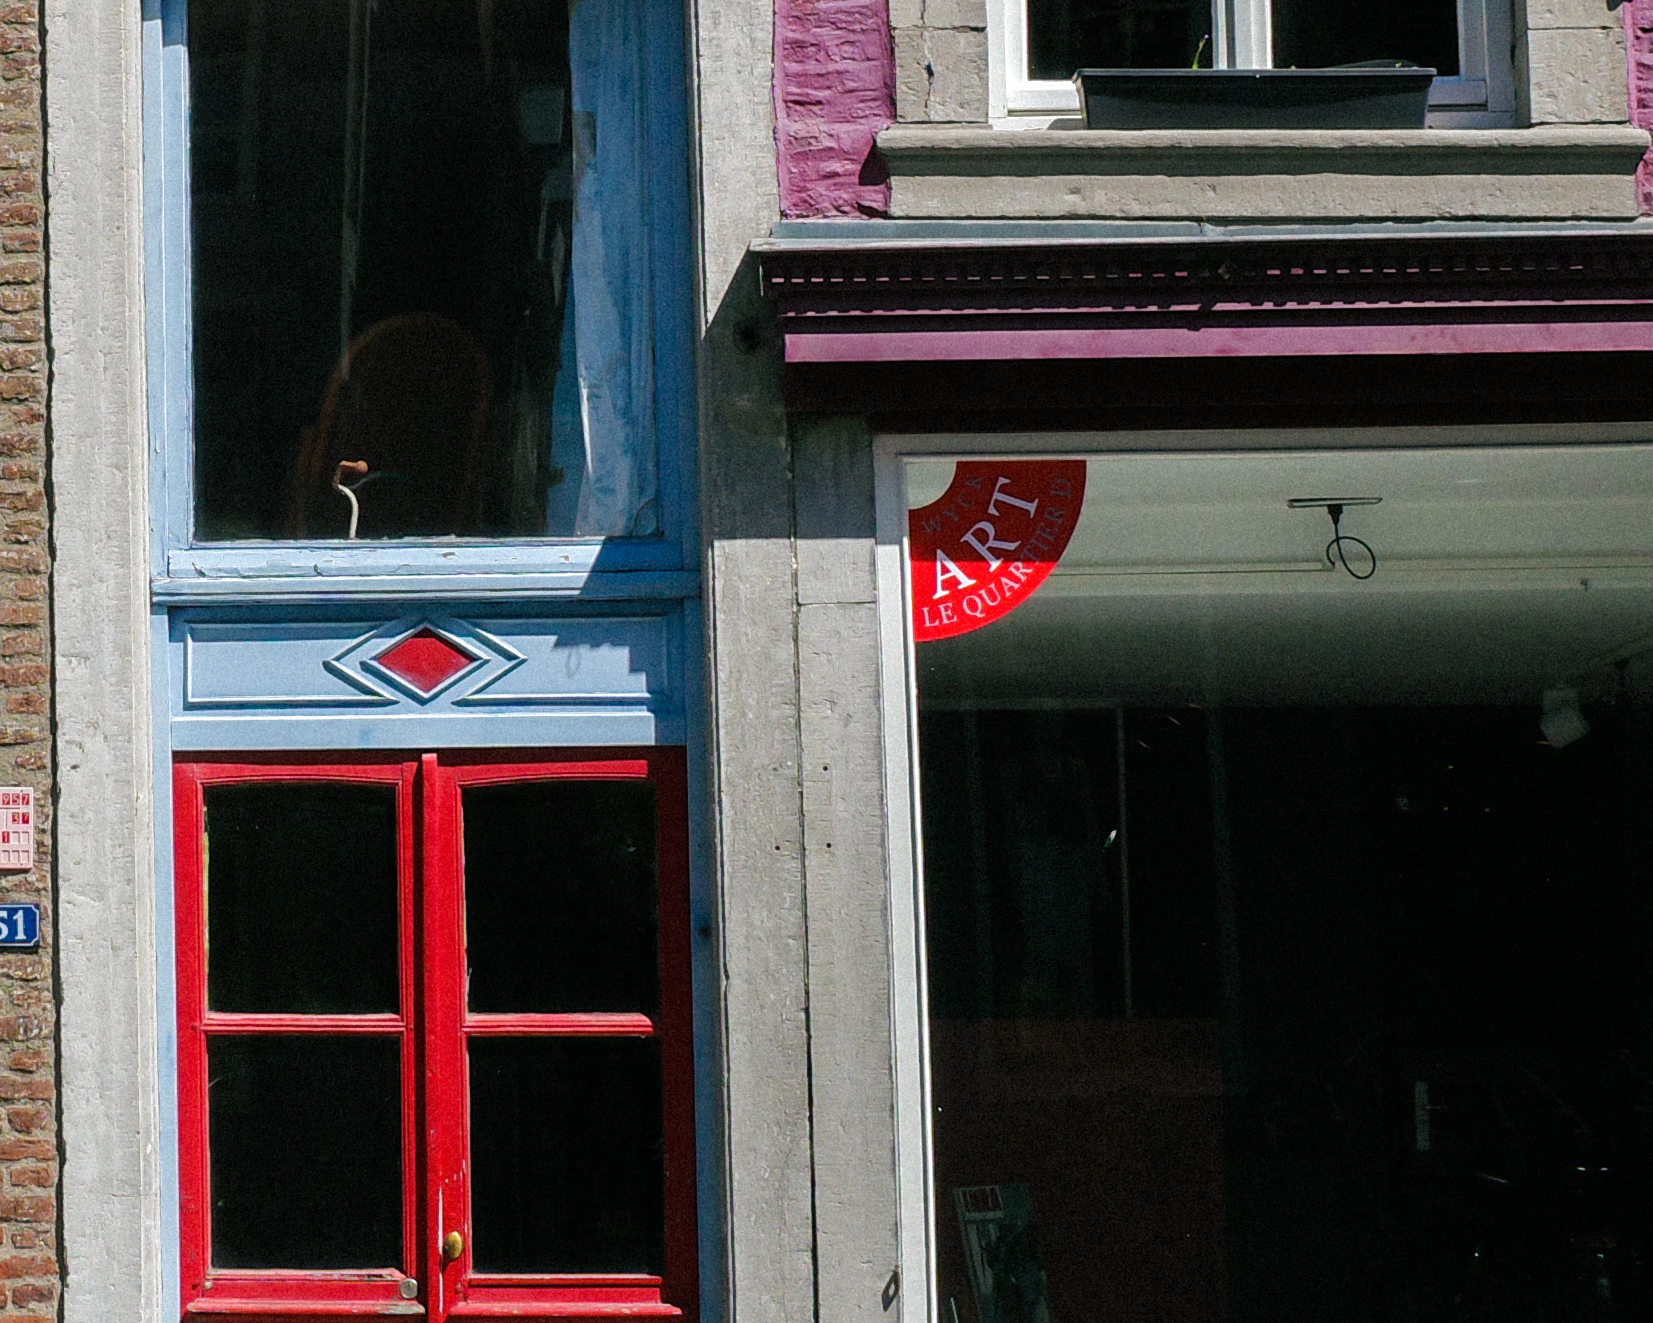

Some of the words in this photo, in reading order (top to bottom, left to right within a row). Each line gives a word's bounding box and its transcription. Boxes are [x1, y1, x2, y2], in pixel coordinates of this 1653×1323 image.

[922, 602, 958, 627] LE
[962, 505, 1066, 618] QUARTIER
[932, 476, 1039, 600] ART
